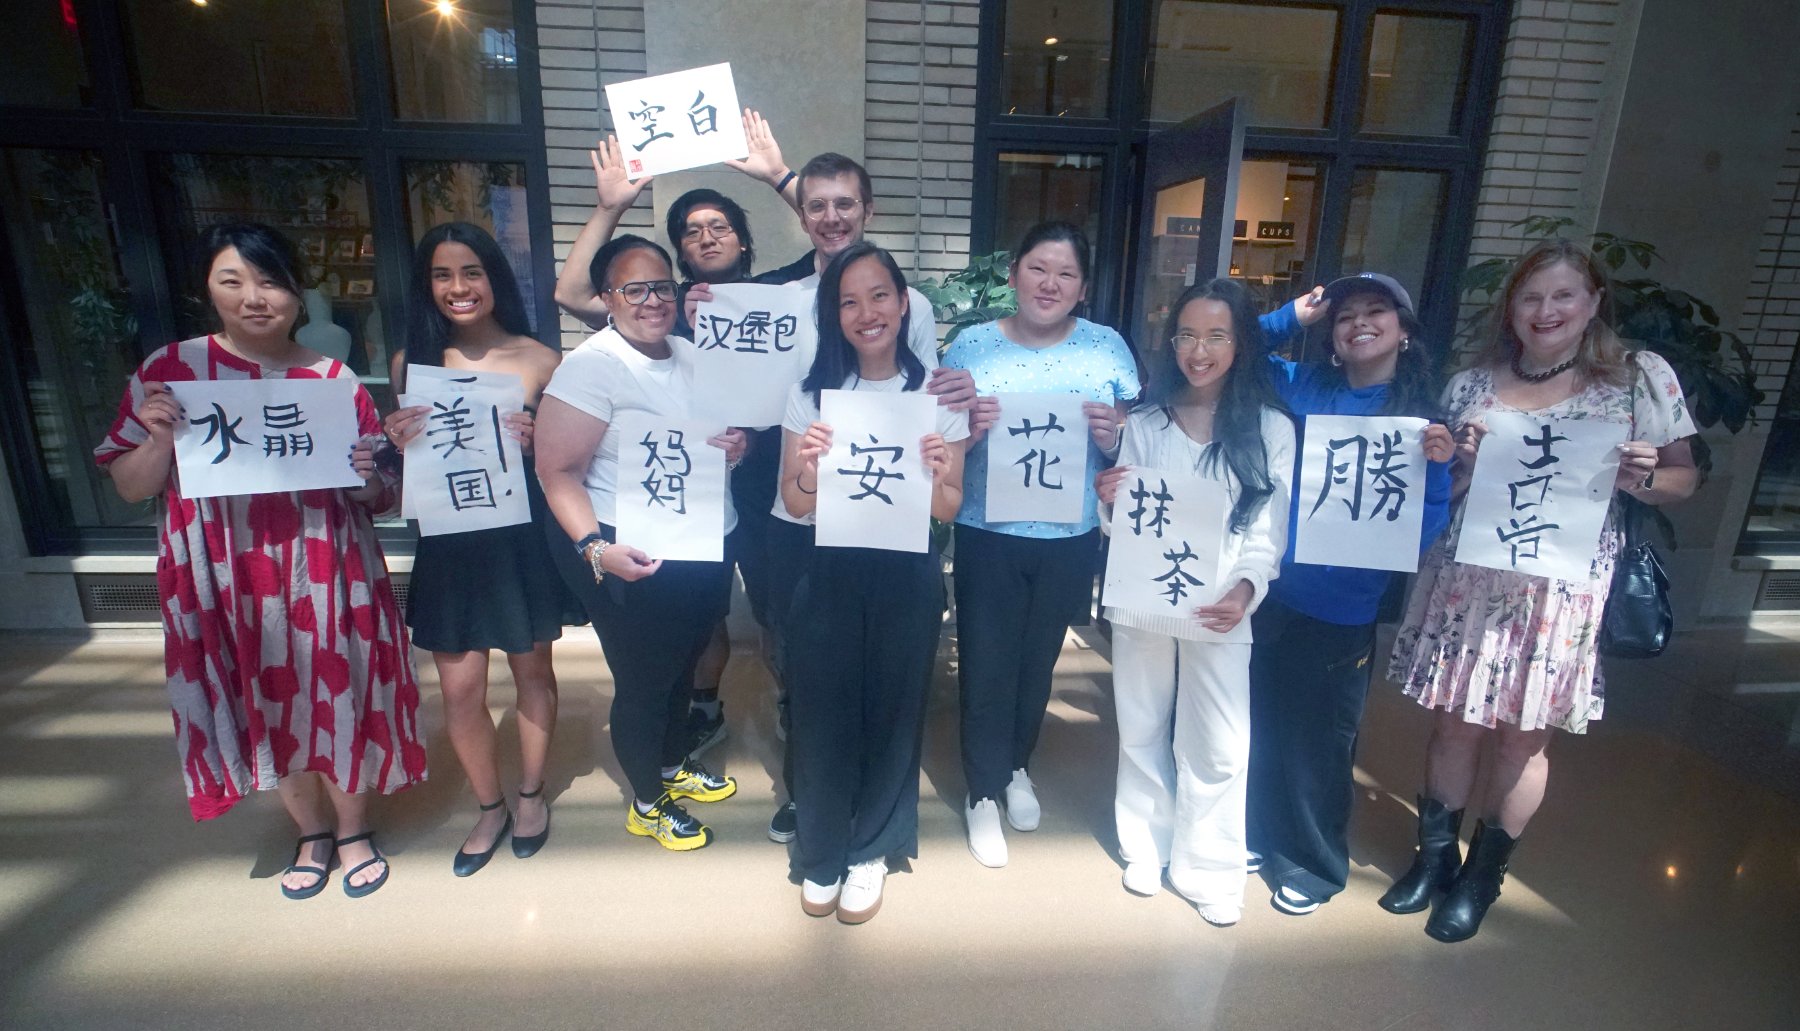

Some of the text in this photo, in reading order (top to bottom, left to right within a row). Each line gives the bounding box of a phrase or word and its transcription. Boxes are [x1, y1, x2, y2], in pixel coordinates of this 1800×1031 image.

[628, 89, 718, 152] 空白
[1262, 227, 1290, 236] CUPS
[698, 311, 797, 353] 汉堡包
[190, 402, 314, 464] 水晶
[837, 433, 906, 506] 安
[1007, 412, 1066, 490] 花
[639, 430, 692, 515] 妈妈
[1307, 430, 1410, 522] 勝
[1128, 477, 1206, 607] 抹茶
